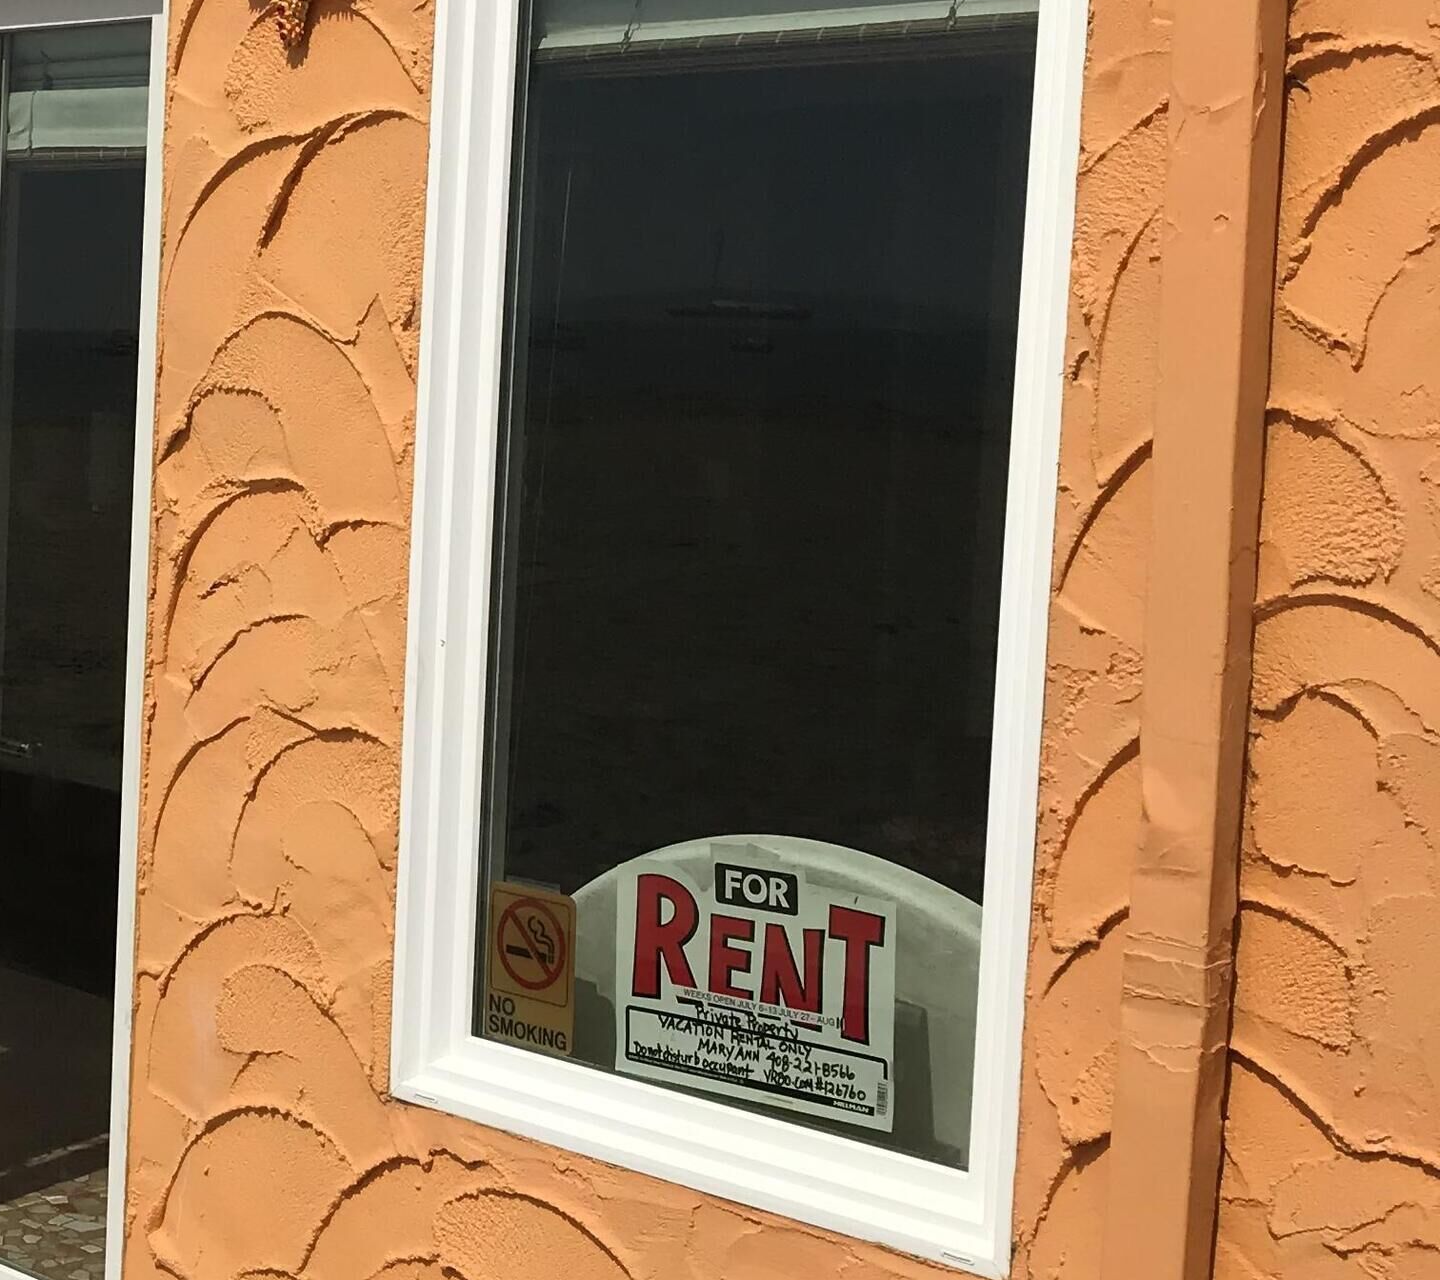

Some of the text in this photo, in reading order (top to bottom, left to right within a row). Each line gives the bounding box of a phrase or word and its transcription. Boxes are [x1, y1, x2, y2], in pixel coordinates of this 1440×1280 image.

[724, 869, 790, 909] FOR
[631, 873, 886, 1046] RENT
[489, 993, 515, 1016] NO
[683, 989, 711, 1001] WEEKS
[713, 995, 736, 1006] OPEN
[737, 999, 757, 1010] JULY
[779, 1009, 799, 1020] JULY
[817, 1017, 835, 1026] AUG
[694, 1003, 799, 1040] Private Property
[489, 1015, 567, 1051] SMOKING
[658, 1014, 812, 1060] VACATION RENTAL ONLY
[698, 1038, 734, 1061] MARY
[735, 1047, 760, 1062] ANN
[663, 1044, 700, 1066] disturb
[832, 1100, 870, 1113] HILLMAN
